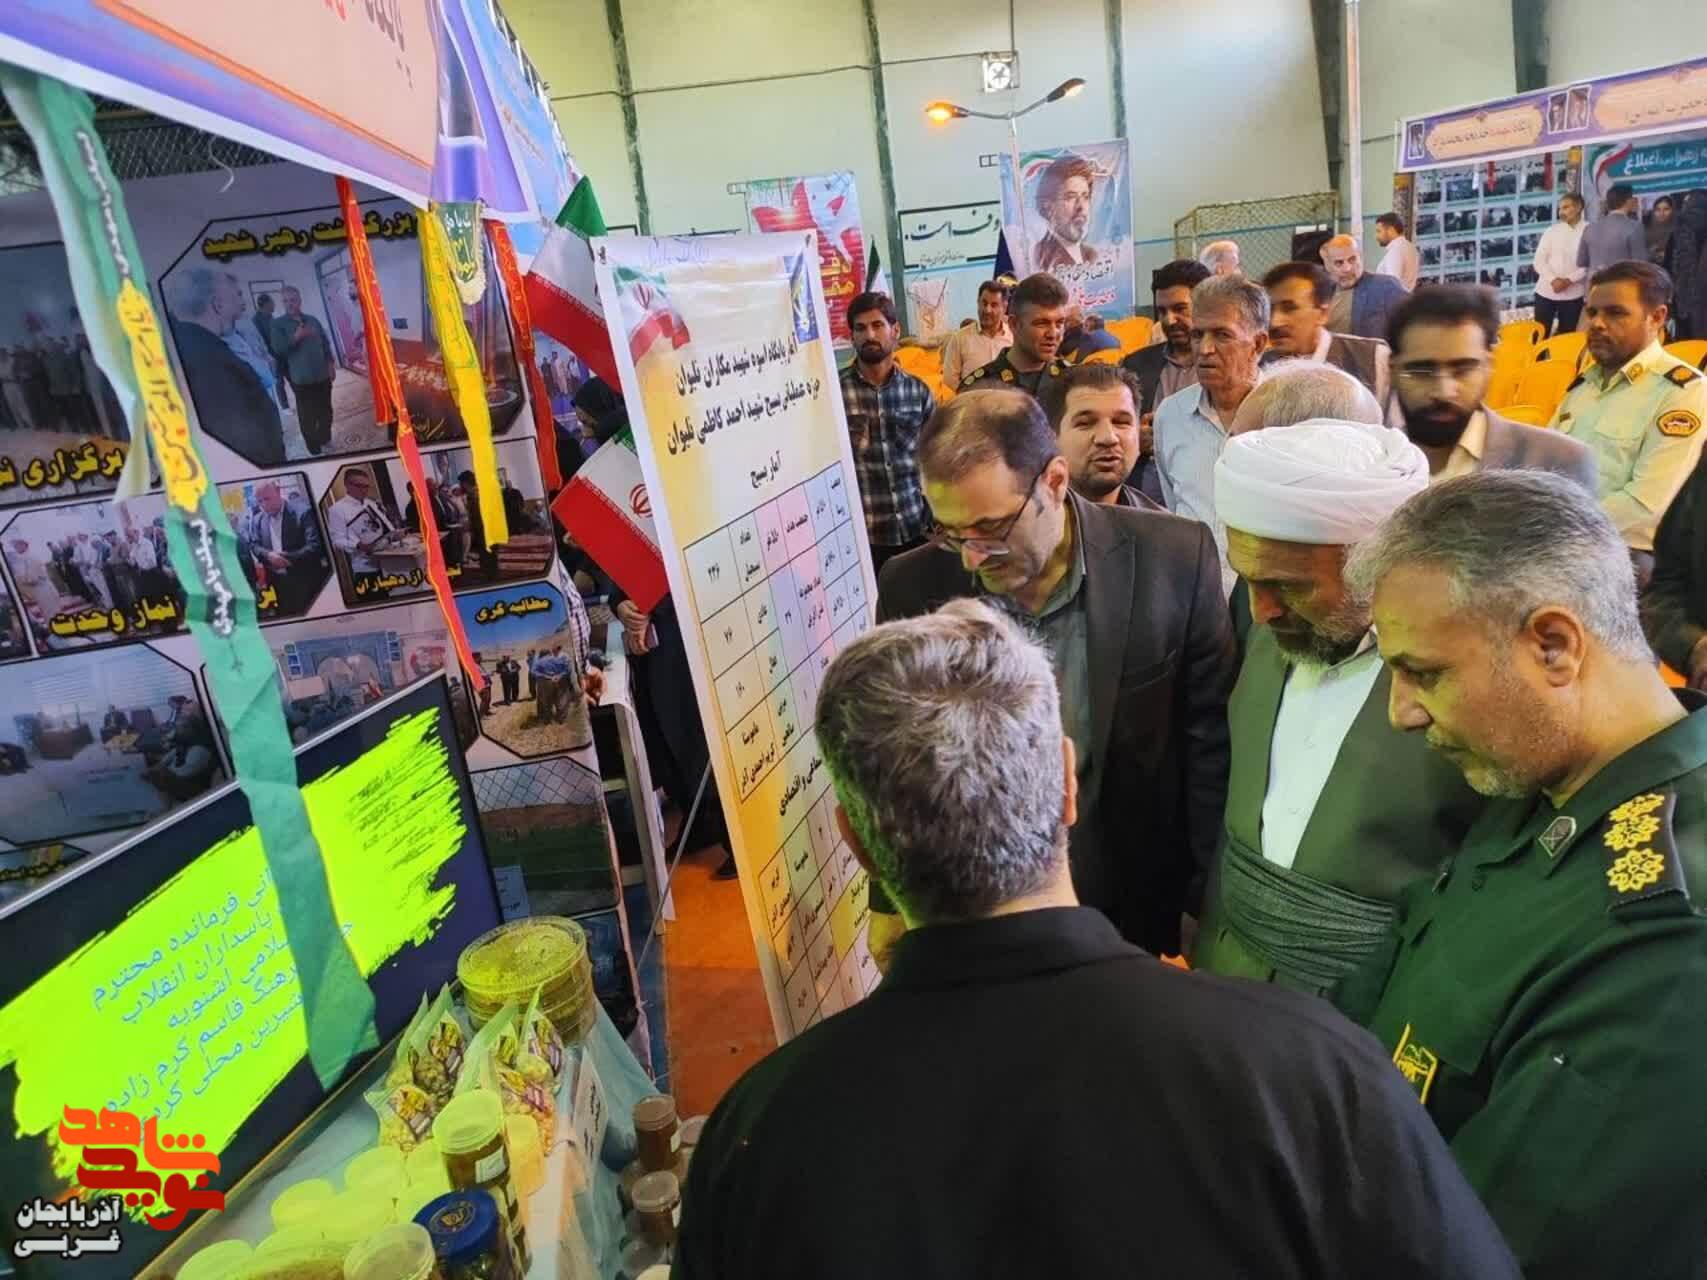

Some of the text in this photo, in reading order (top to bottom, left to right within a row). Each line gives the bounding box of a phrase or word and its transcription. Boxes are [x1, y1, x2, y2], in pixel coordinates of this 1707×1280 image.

[733, 346, 751, 378] شهید
[726, 398, 746, 428] احمد
[747, 393, 764, 422] شهید
[24, 442, 122, 487] برگزاری
[52, 595, 177, 635] نماز وحدت
[508, 597, 550, 617] مطالبه
[94, 891, 238, 1013] فرمانده محترم
[122, 962, 187, 1025] انقلاب
[168, 967, 233, 1029] اشنویه
[251, 962, 297, 1005] رهنگ
[199, 996, 243, 1058] قاسم
[157, 1036, 190, 1087] کرم
[193, 1042, 242, 1096] محلی
